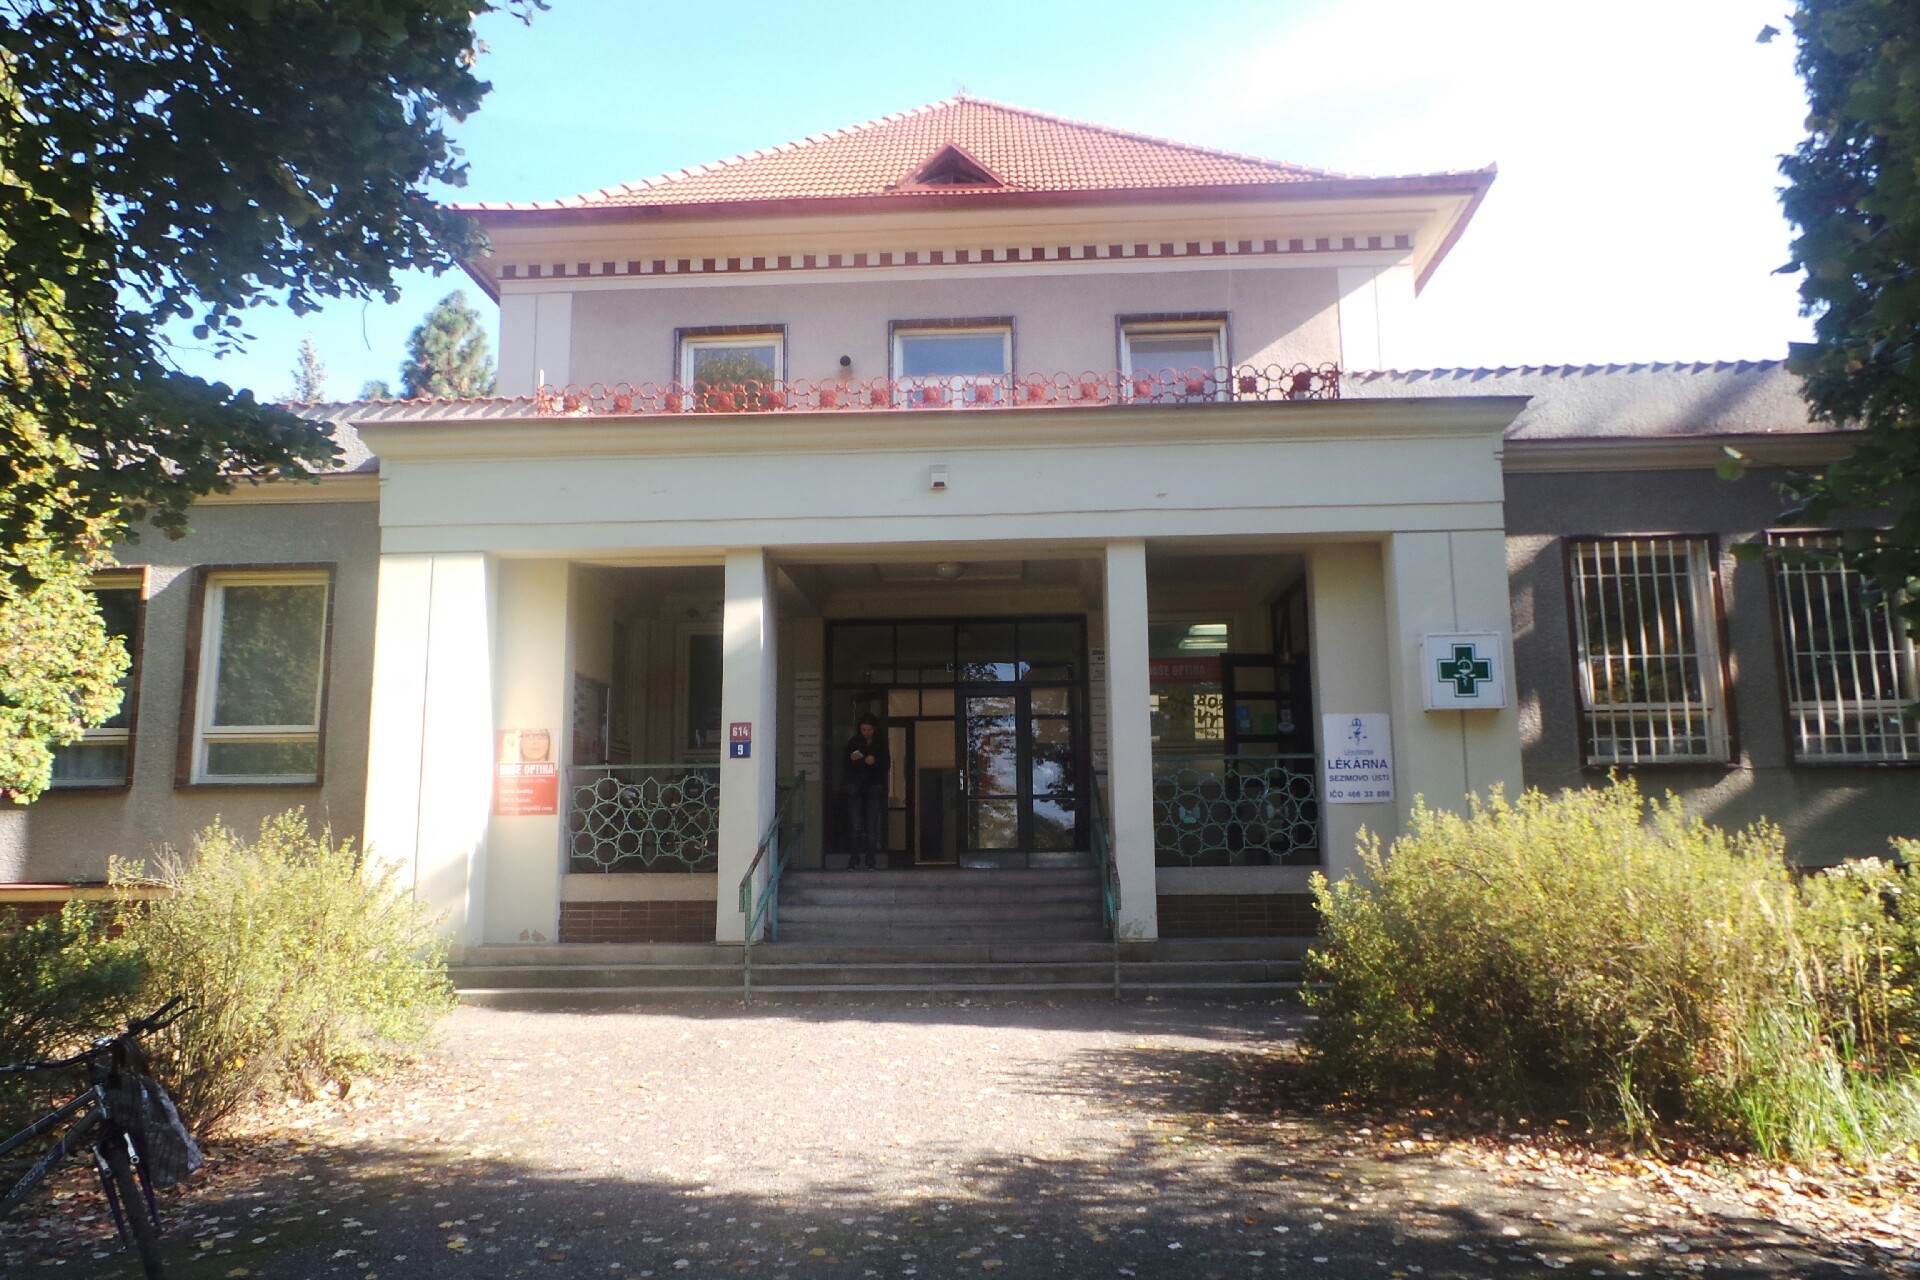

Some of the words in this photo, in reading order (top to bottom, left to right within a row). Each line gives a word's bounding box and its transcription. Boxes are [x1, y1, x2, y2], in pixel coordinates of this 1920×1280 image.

[733, 727, 748, 736] 614
[738, 745, 743, 755] 9
[1328, 757, 1388, 769] LÉKÁRNA
[524, 764, 554, 775] OPTIKA
[1329, 789, 1344, 798] IČO
